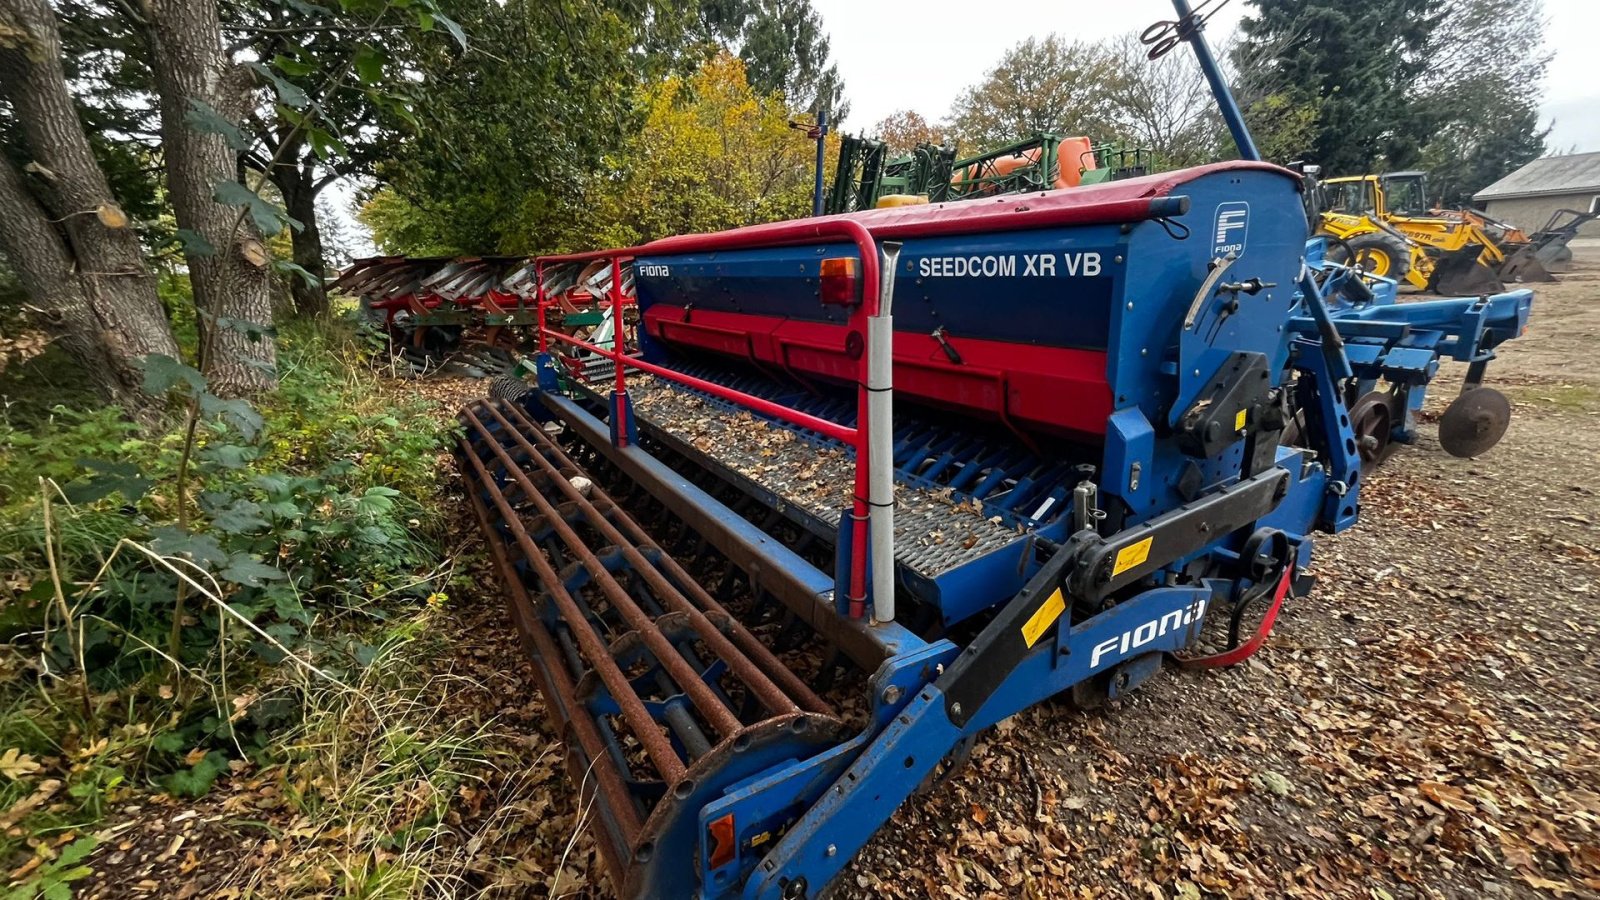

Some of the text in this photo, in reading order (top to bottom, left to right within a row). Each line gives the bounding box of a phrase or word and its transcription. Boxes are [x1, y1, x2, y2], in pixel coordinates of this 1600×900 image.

[919, 252, 1102, 277] SEEDCOM XR VB
